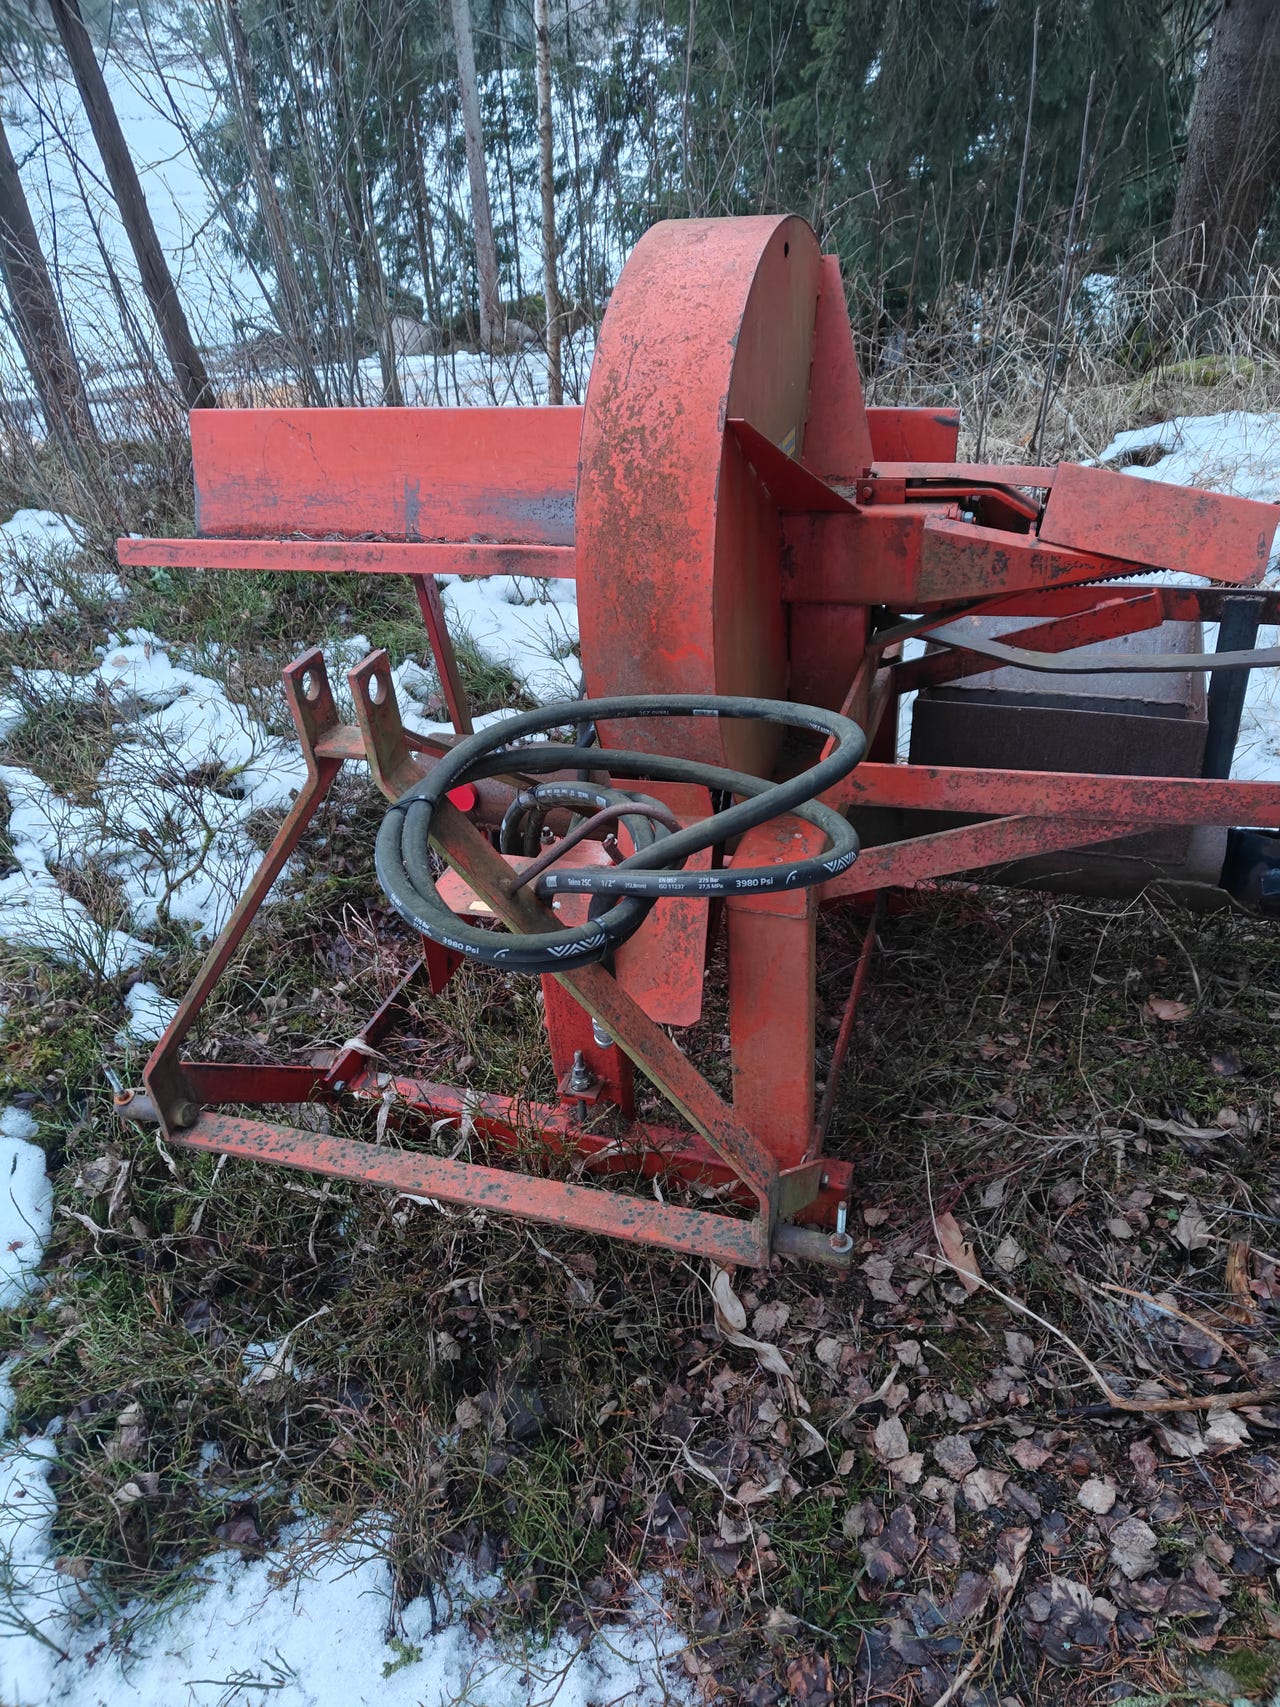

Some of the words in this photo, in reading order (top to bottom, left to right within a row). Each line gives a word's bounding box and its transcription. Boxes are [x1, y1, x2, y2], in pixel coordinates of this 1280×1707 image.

[735, 878, 759, 888] 3980
[760, 876, 774, 886] Psi
[442, 936, 464, 951] 3980
[465, 945, 480, 955] Psi
